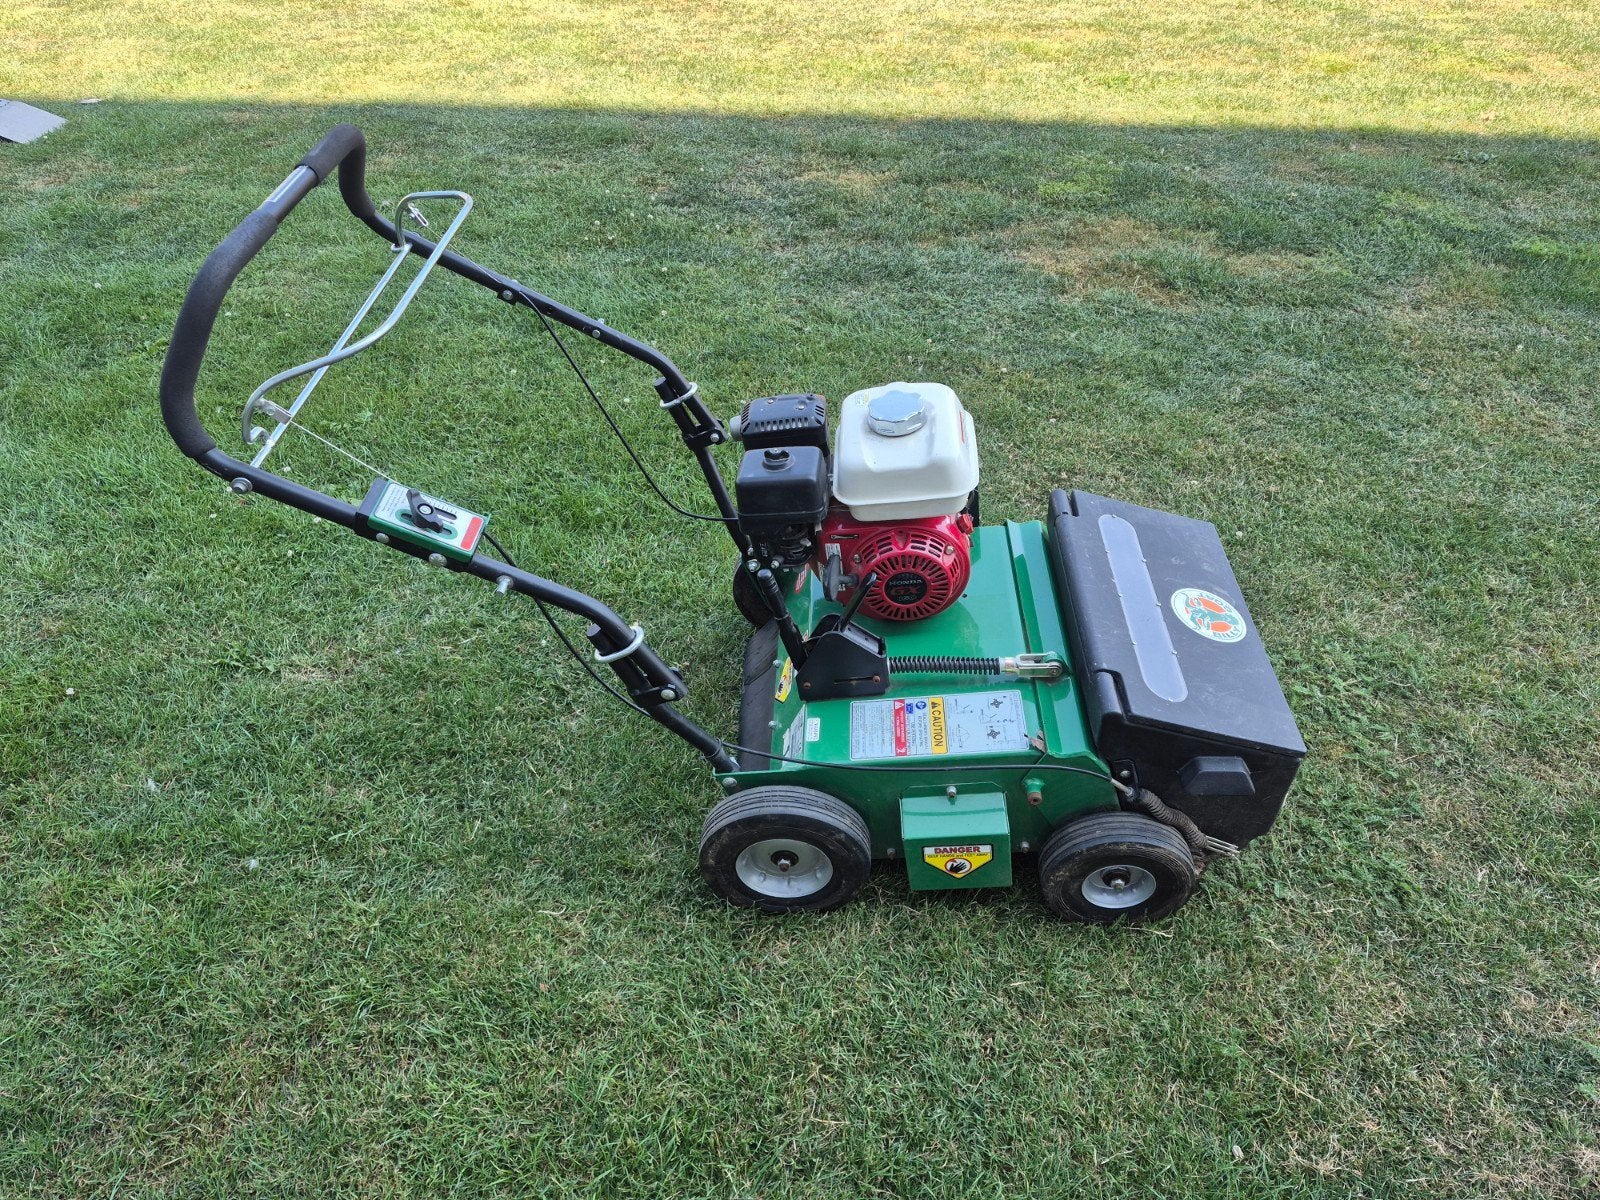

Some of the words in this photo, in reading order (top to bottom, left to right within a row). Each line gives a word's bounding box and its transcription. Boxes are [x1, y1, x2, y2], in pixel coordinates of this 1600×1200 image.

[1212, 625, 1240, 638] BILLY
[931, 709, 944, 747] CAUTION
[934, 846, 981, 854] DANGER
